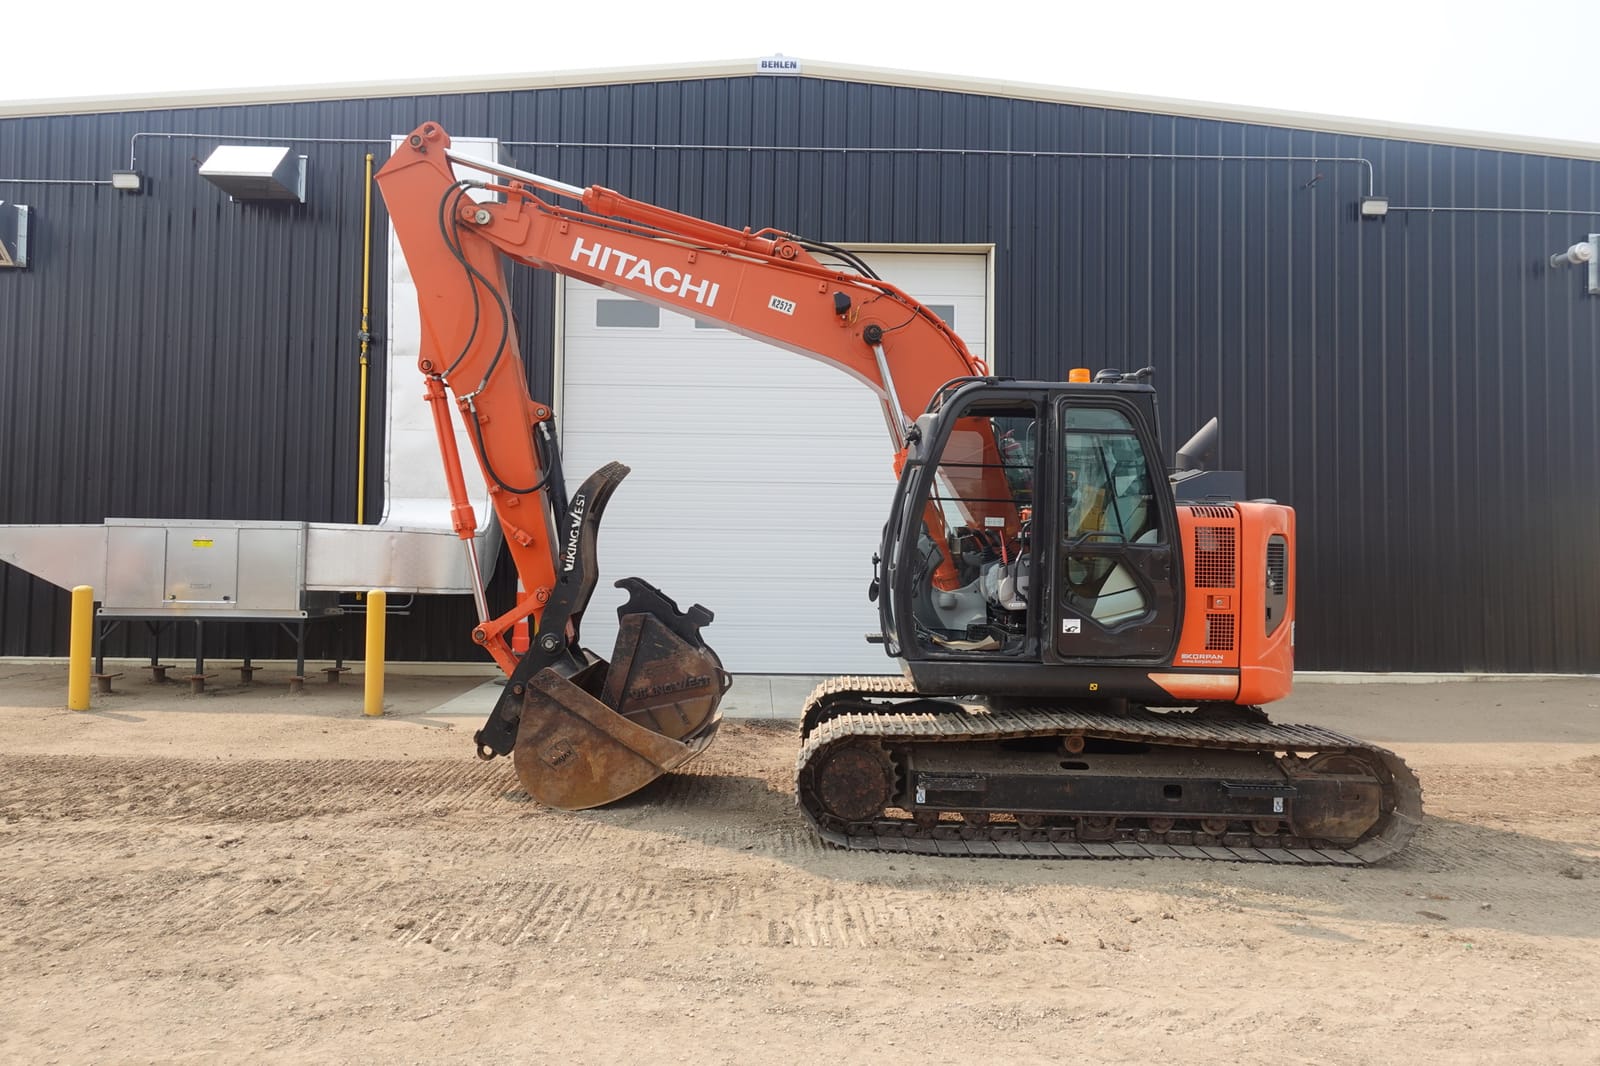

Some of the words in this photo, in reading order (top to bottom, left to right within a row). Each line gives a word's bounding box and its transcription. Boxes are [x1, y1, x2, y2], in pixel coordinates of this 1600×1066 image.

[761, 60, 797, 69] BEHLEN
[570, 237, 720, 307] HITACHI
[771, 298, 793, 313] K2572
